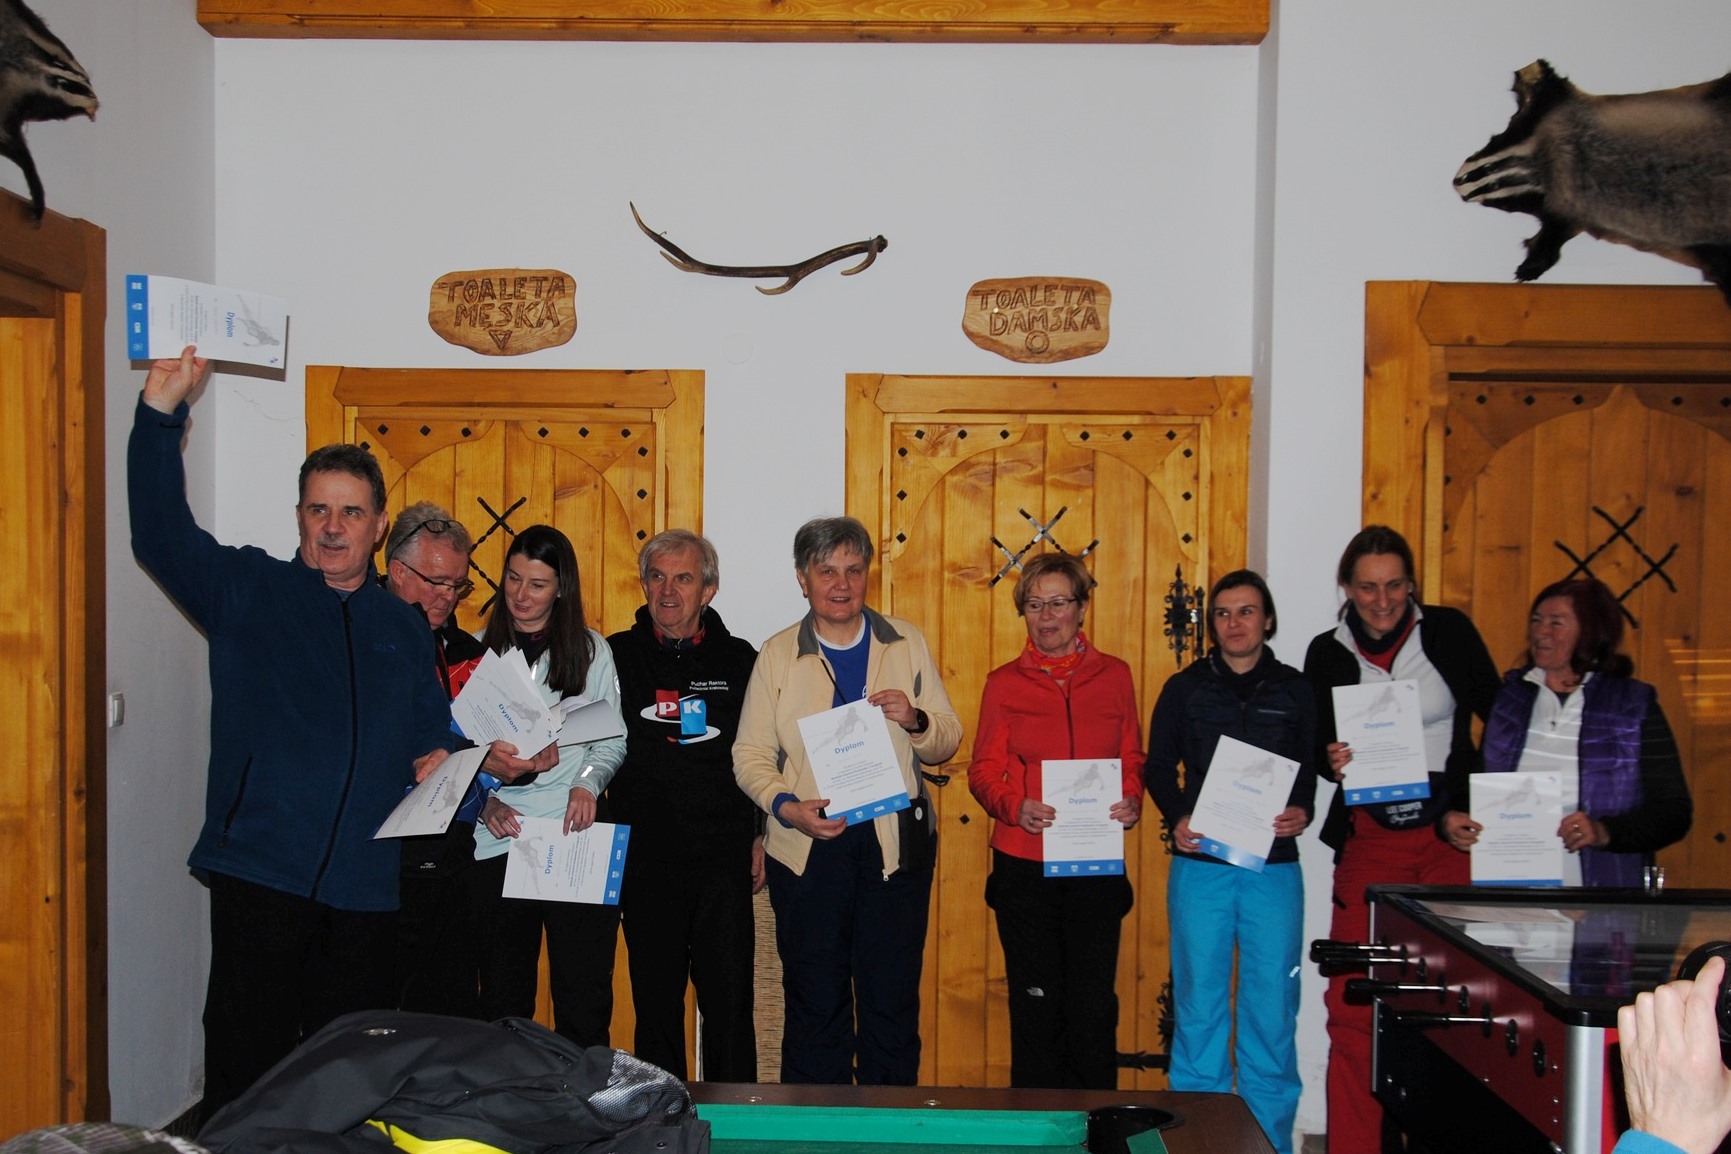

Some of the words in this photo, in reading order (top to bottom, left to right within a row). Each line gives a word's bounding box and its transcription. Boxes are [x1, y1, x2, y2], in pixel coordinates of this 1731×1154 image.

[438, 276, 566, 303] TOALETA
[973, 284, 1096, 311] TOALETA
[224, 311, 235, 338] Dyplom
[989, 306, 1102, 336] DAMSKA
[498, 703, 519, 733] Dyplom
[834, 740, 865, 755] Dyplom
[427, 775, 448, 807] Dyplom
[1068, 797, 1098, 805] Dyplom
[544, 844, 554, 875] Dyplom
